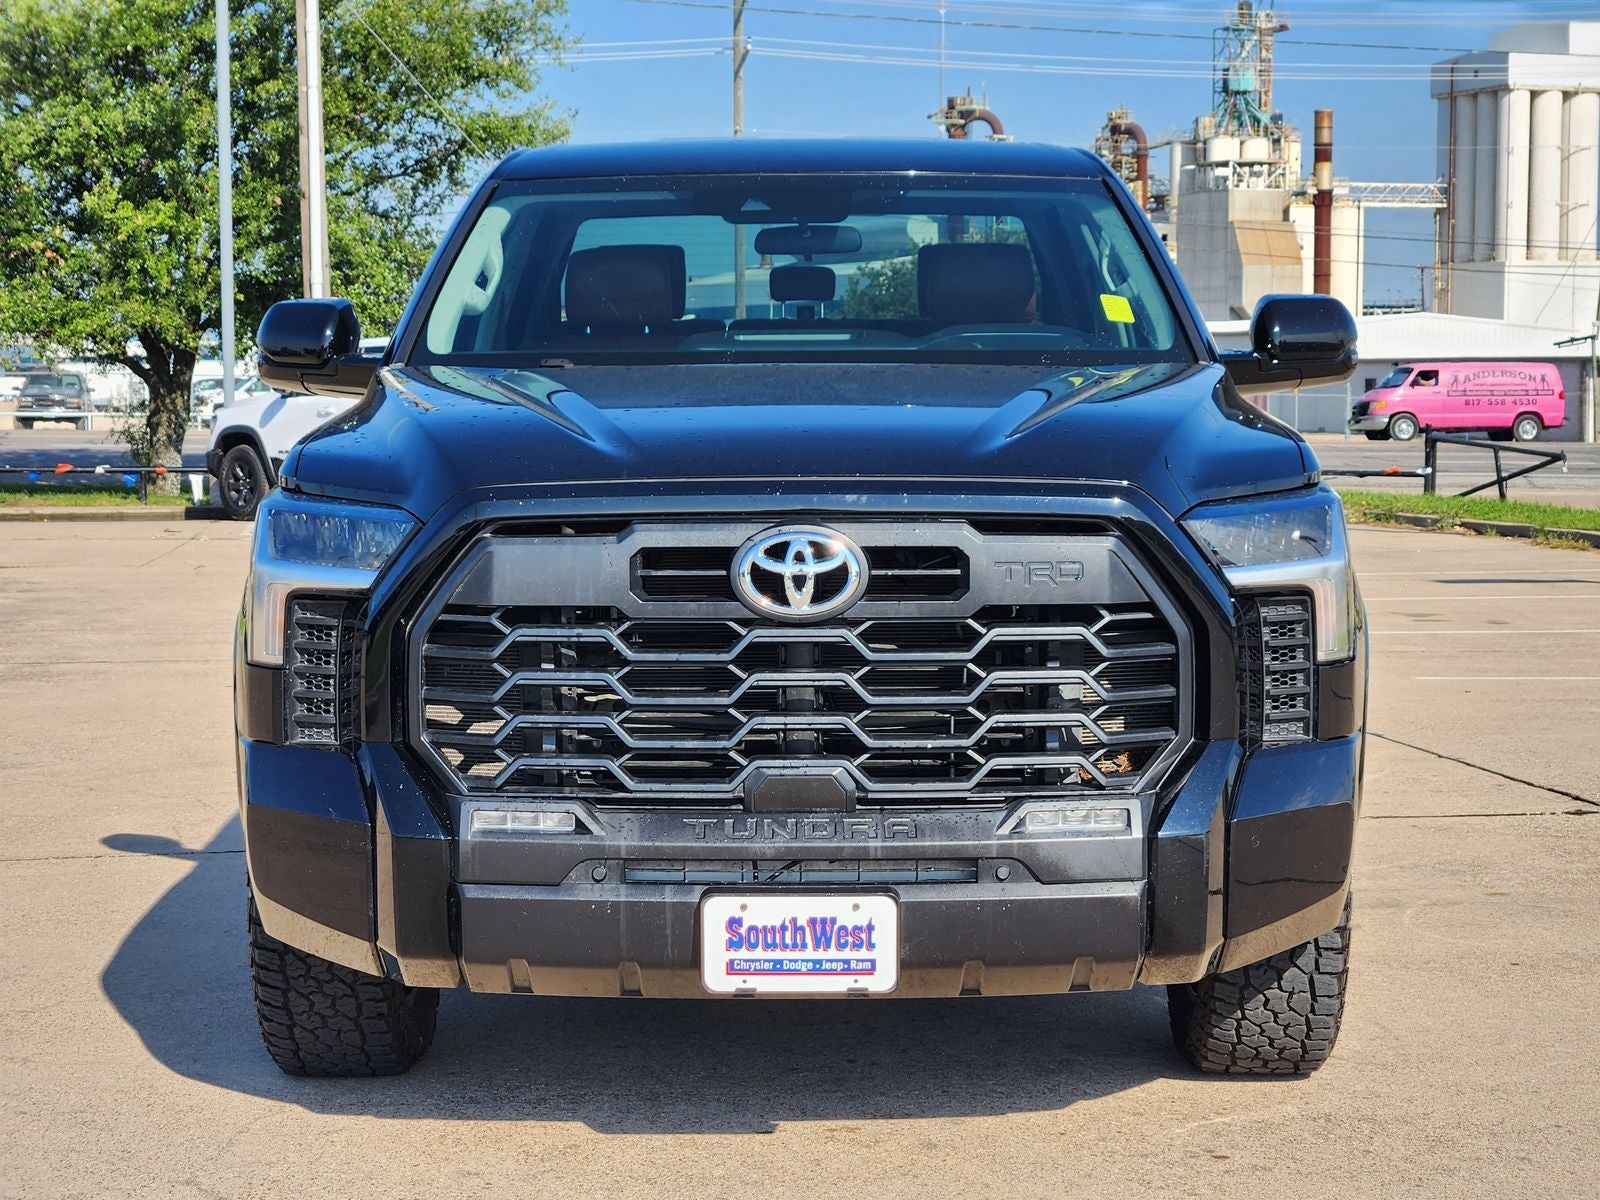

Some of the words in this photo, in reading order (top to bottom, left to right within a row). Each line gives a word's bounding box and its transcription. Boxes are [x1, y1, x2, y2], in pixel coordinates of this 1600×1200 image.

[1463, 370, 1537, 383] ANDERSON
[993, 561, 1084, 587] TRD
[682, 818, 917, 839] TUNDRA
[733, 960, 774, 971] Chrysler
[782, 960, 813, 971] Dodge
[821, 960, 843, 971] Jeep
[850, 960, 872, 970] Ram
